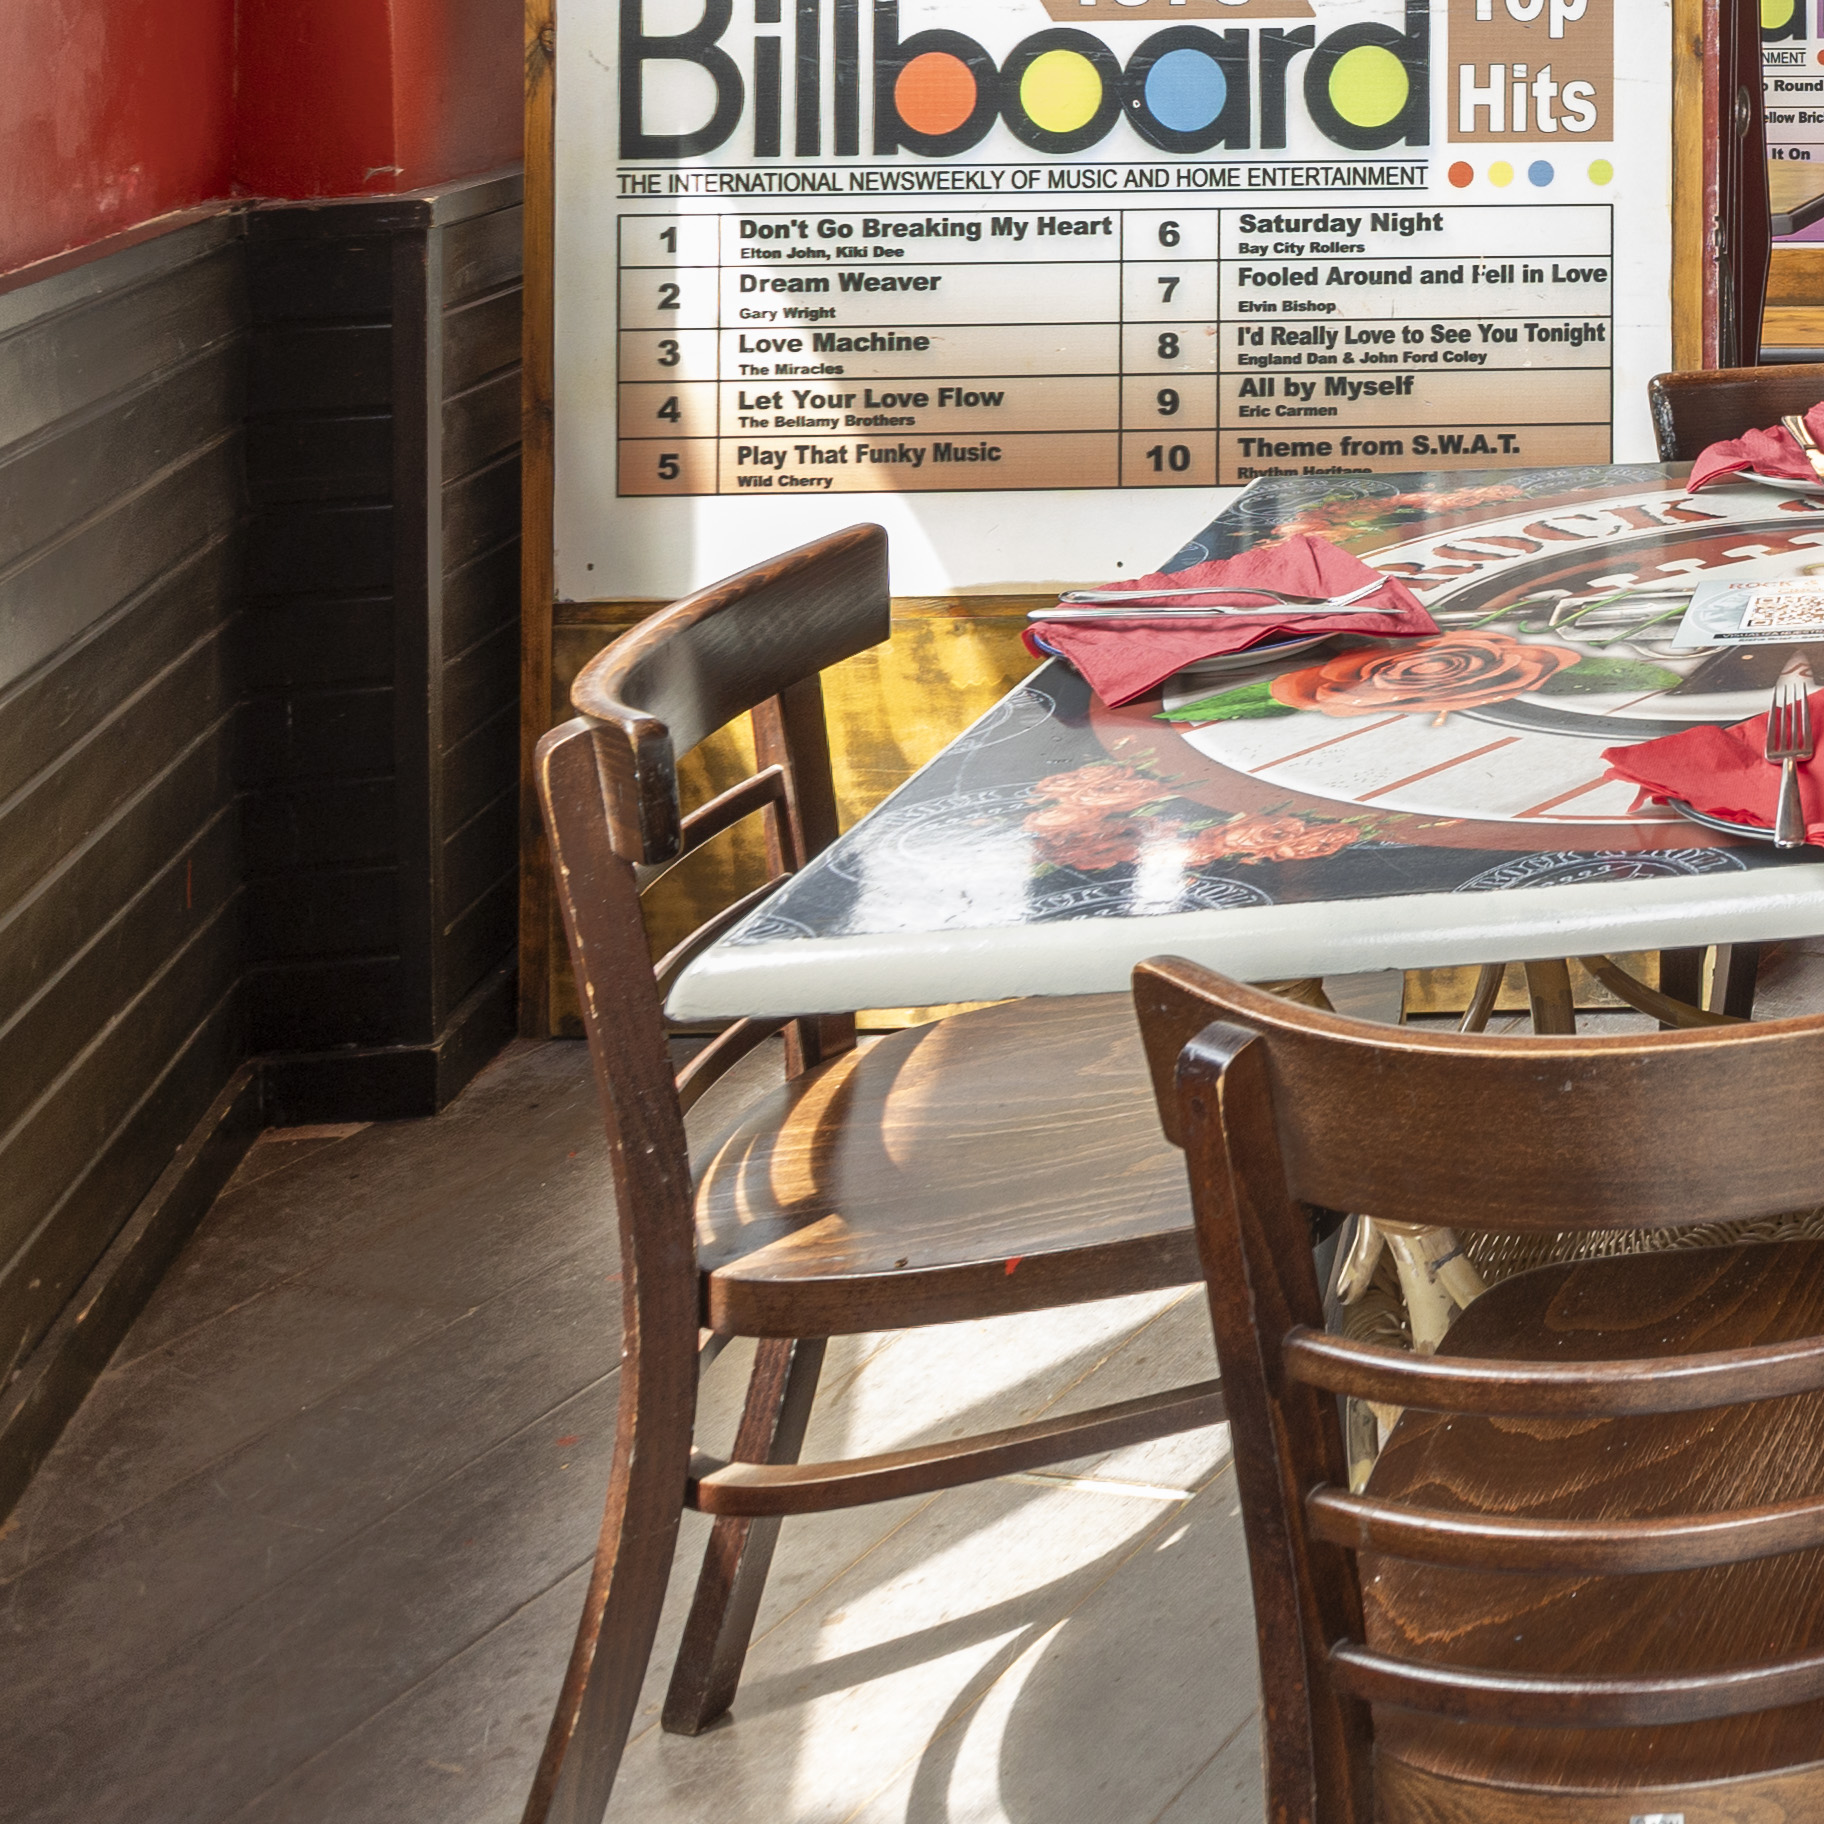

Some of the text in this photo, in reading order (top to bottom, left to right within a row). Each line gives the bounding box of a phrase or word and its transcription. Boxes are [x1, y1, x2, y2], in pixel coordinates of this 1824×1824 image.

[1458, 62, 1599, 134] Hits
[1774, 79, 1824, 92] Round
[618, 165, 1429, 194] THE INTERNATIONAL NEWSWEEKLY OF MUSIC AND HOME ENTERTAINMENT
[659, 216, 1113, 253] 1 Don't Go Breaking My Heart
[1158, 212, 1444, 247] 6 Saturday Night
[657, 272, 942, 310] 2 Dream Weaver
[1157, 263, 1608, 303] 7 Fooled Around and Fell in Love
[657, 332, 931, 366] 3 Love Machine
[1157, 322, 1606, 359] 8 I'd Really Love to See You Tonight
[657, 387, 1005, 423] 4 Let Your Love Flow
[1157, 375, 1415, 416] 9 All by Myself
[657, 442, 1002, 480] 5 Play That Funky Music
[1145, 433, 1520, 473] 10 Theme from S.W.A.T.
